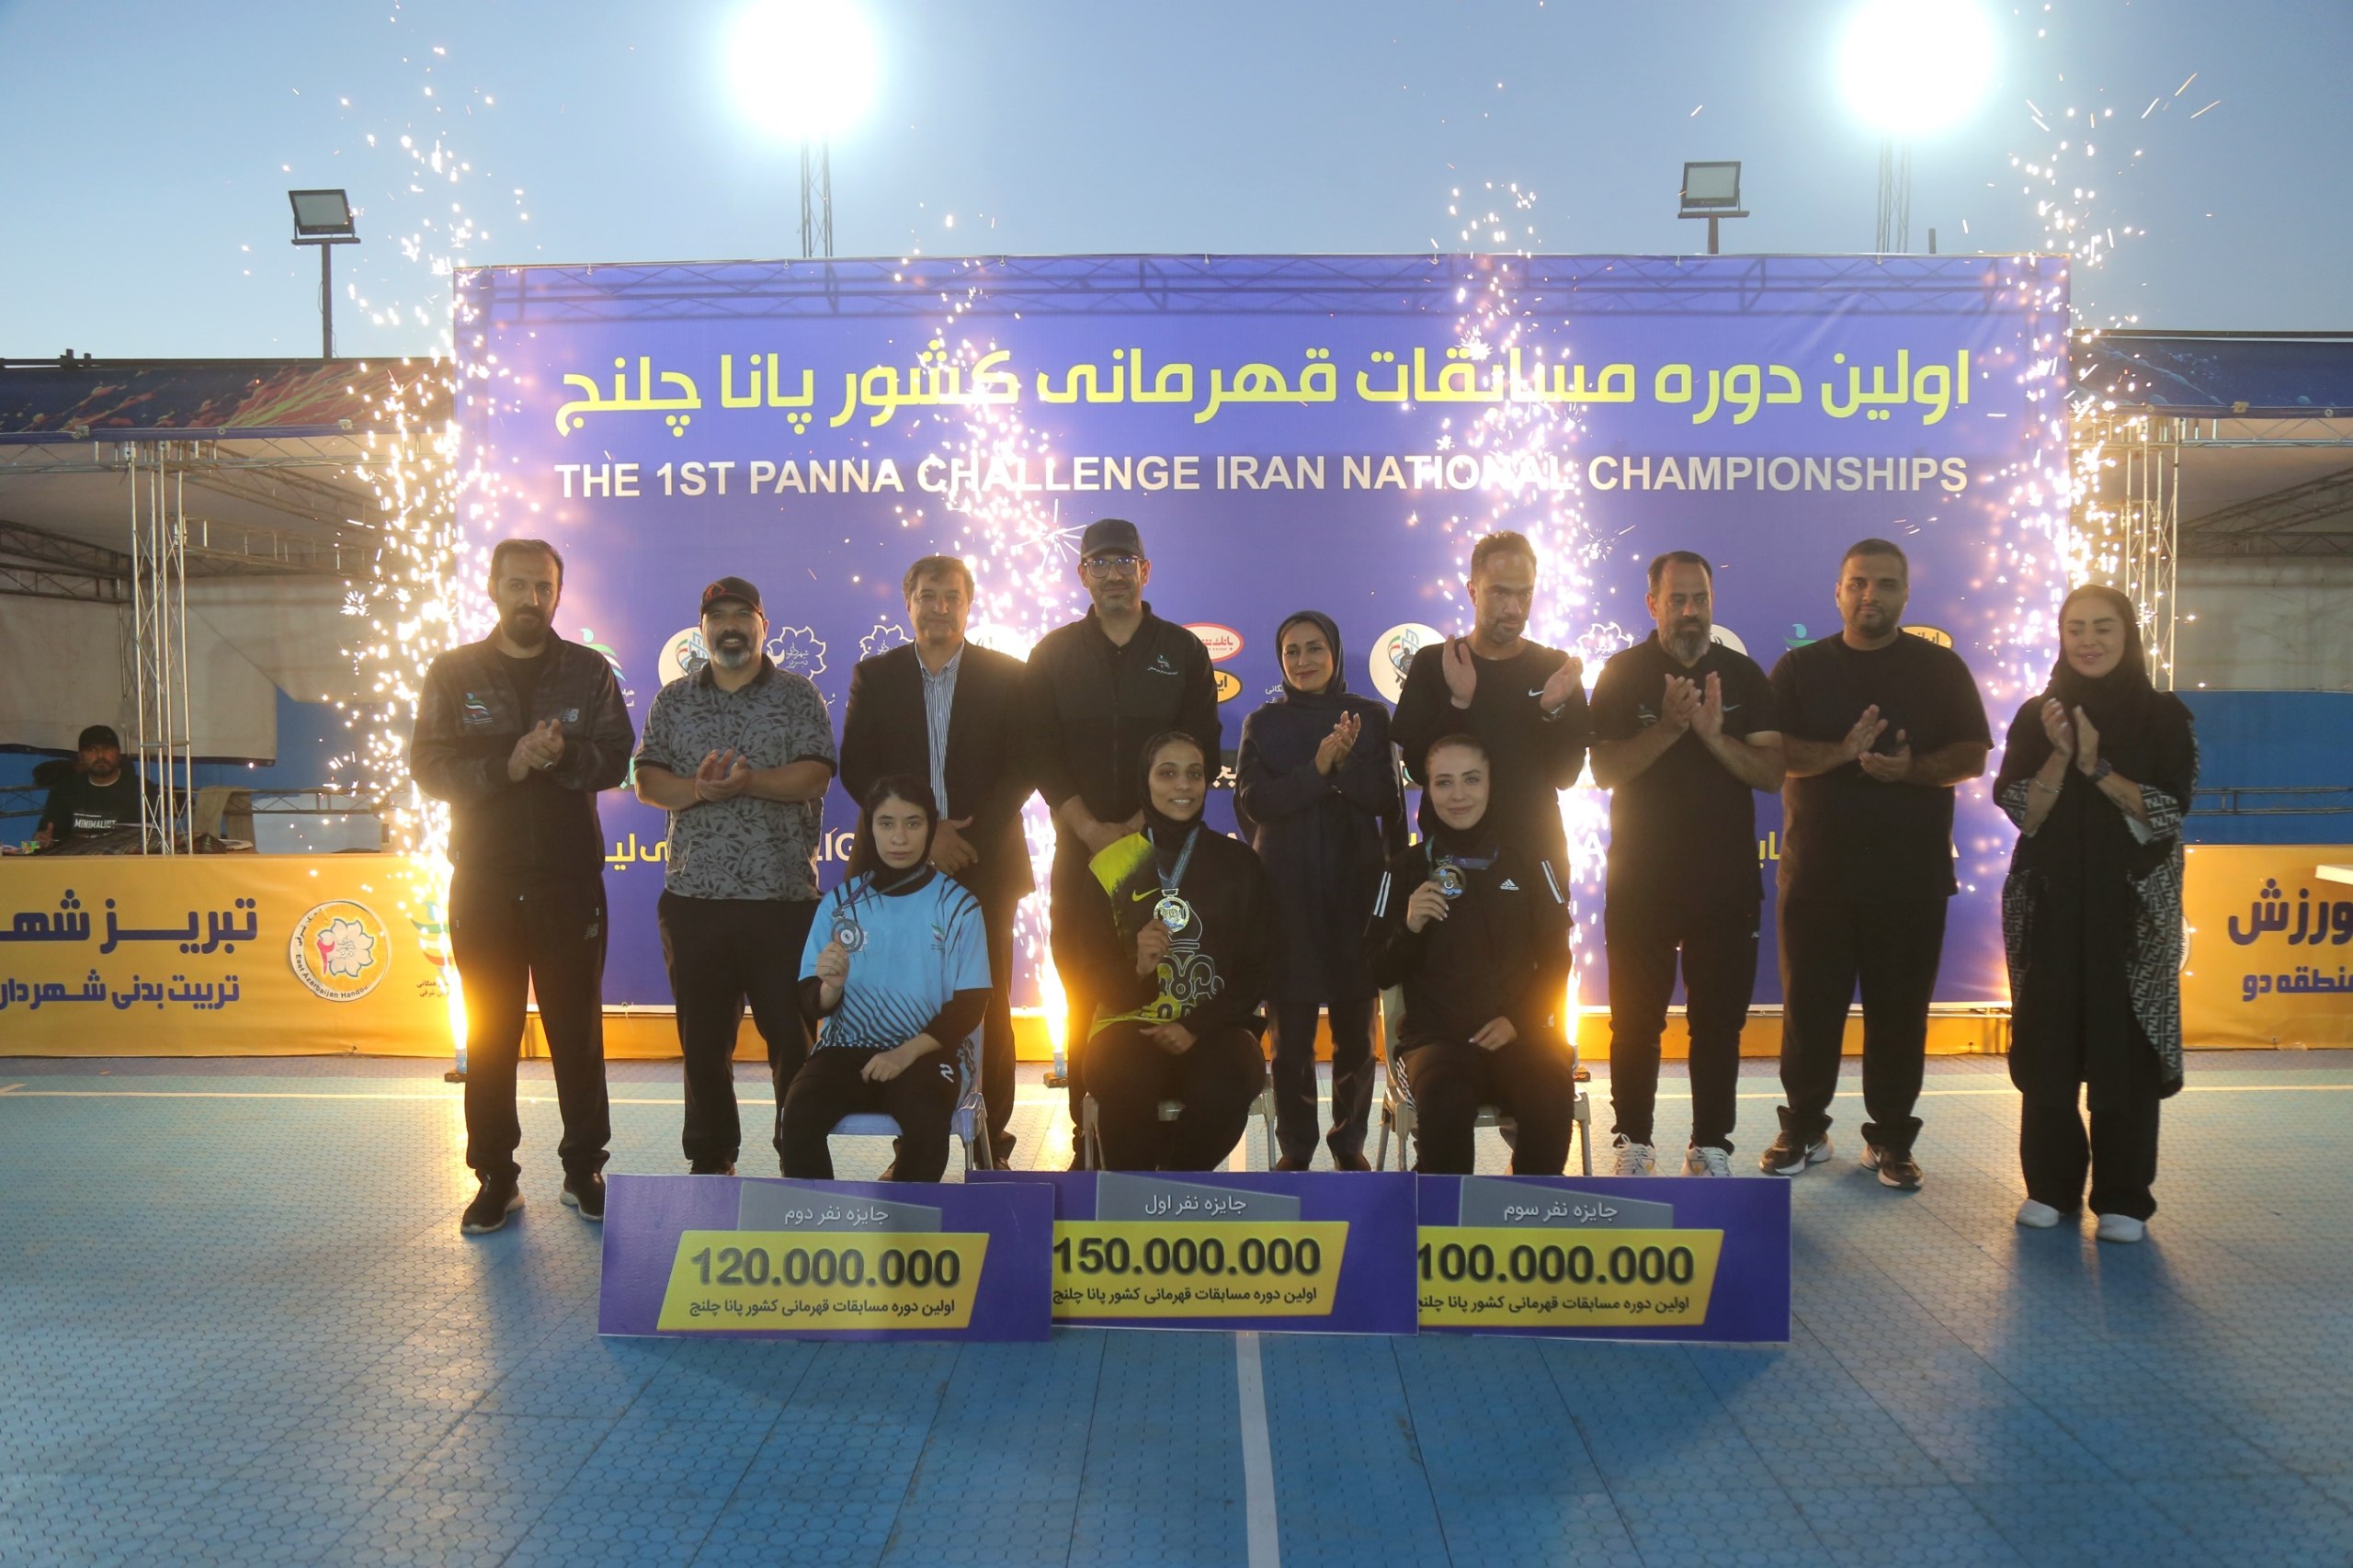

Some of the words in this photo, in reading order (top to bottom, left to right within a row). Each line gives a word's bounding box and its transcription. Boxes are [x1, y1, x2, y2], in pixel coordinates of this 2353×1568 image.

[830, 339, 1017, 427] کشور
[1037, 347, 1336, 424] قهرمانی
[1355, 347, 1636, 419] مسابقات
[1821, 349, 1969, 425] اولین
[555, 357, 701, 437] چلنج
[721, 354, 814, 434] پانا
[1655, 363, 1802, 425] دوره
[555, 461, 640, 497] THE
[656, 460, 734, 496] 1ST
[750, 458, 905, 494] PANNA
[917, 456, 1200, 493] CHALLENGE
[1217, 456, 1326, 490] IRAN
[1344, 455, 1574, 491] NATIONAL
[1587, 455, 1969, 493] CHAMPIONSHIPS
[99, 897, 257, 955] تبریز
[0, 969, 108, 1011] شهردار
[111, 974, 164, 1010] بدنی
[168, 974, 240, 1010] تربیت
[2243, 974, 2272, 1002] دو
[1145, 1195, 1171, 1215] اول
[1176, 1196, 1199, 1216] نفر
[1205, 1195, 1246, 1216] جایزه
[1504, 1204, 1540, 1221] سوم
[1542, 1202, 1569, 1222] نفر
[1573, 1202, 1618, 1223] جایزه
[784, 1207, 813, 1225] دوم
[817, 1206, 841, 1225] نفر
[846, 1206, 889, 1225] جایزه
[1053, 1236, 1321, 1276] 150.000.000
[1417, 1243, 1695, 1285] 100.000.000
[691, 1246, 961, 1288] 120.000.000
[1052, 1287, 1083, 1305] چلنج
[1086, 1288, 1105, 1305] پانا
[1108, 1287, 1140, 1304] کشور
[1144, 1287, 1192, 1304] قهرمانی
[1195, 1287, 1251, 1303] مسابقات
[1253, 1290, 1280, 1305] دوره
[1284, 1287, 1317, 1304] اولین
[1448, 1296, 1468, 1313] پانا
[1471, 1296, 1505, 1313] کشور
[1509, 1296, 1559, 1313] قهرمانی
[1563, 1296, 1620, 1313] مسابقات
[1655, 1296, 1689, 1313] اولین
[689, 1299, 721, 1317] چلنج
[724, 1299, 743, 1317] پانا
[745, 1299, 779, 1316] کشور
[781, 1299, 829, 1316] قهرمانی
[833, 1300, 889, 1316] مسابقات
[891, 1301, 918, 1316] دوره
[922, 1299, 955, 1316] اولین
[1623, 1299, 1651, 1314] دوره
